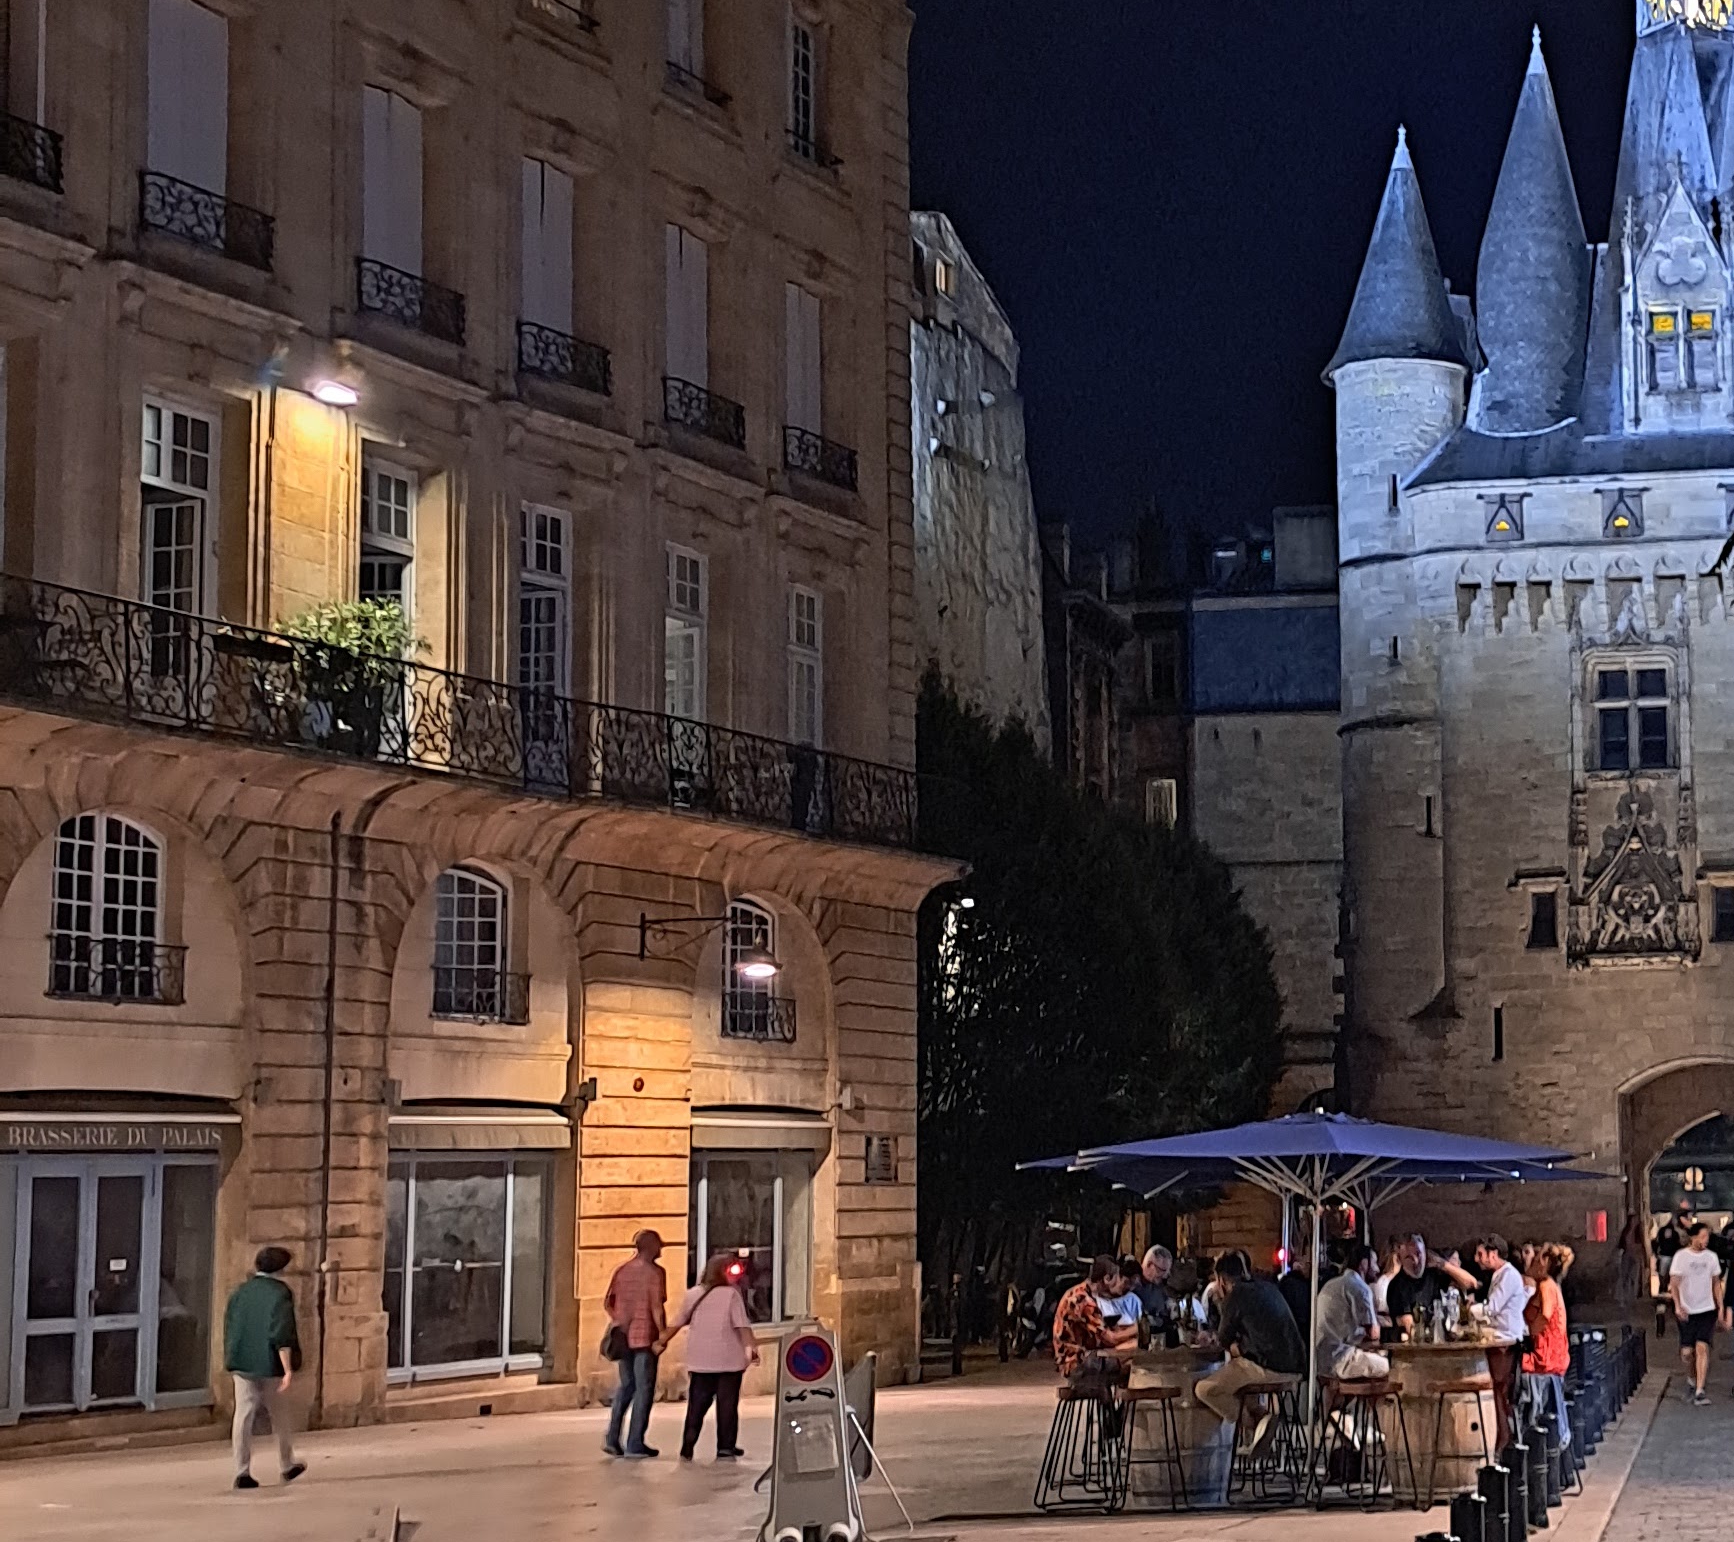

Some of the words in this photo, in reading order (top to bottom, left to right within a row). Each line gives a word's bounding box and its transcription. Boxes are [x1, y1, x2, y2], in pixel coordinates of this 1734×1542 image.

[8, 1126, 118, 1146] BRASSERIE
[127, 1127, 153, 1146] DU
[162, 1126, 223, 1145] PALAIS
